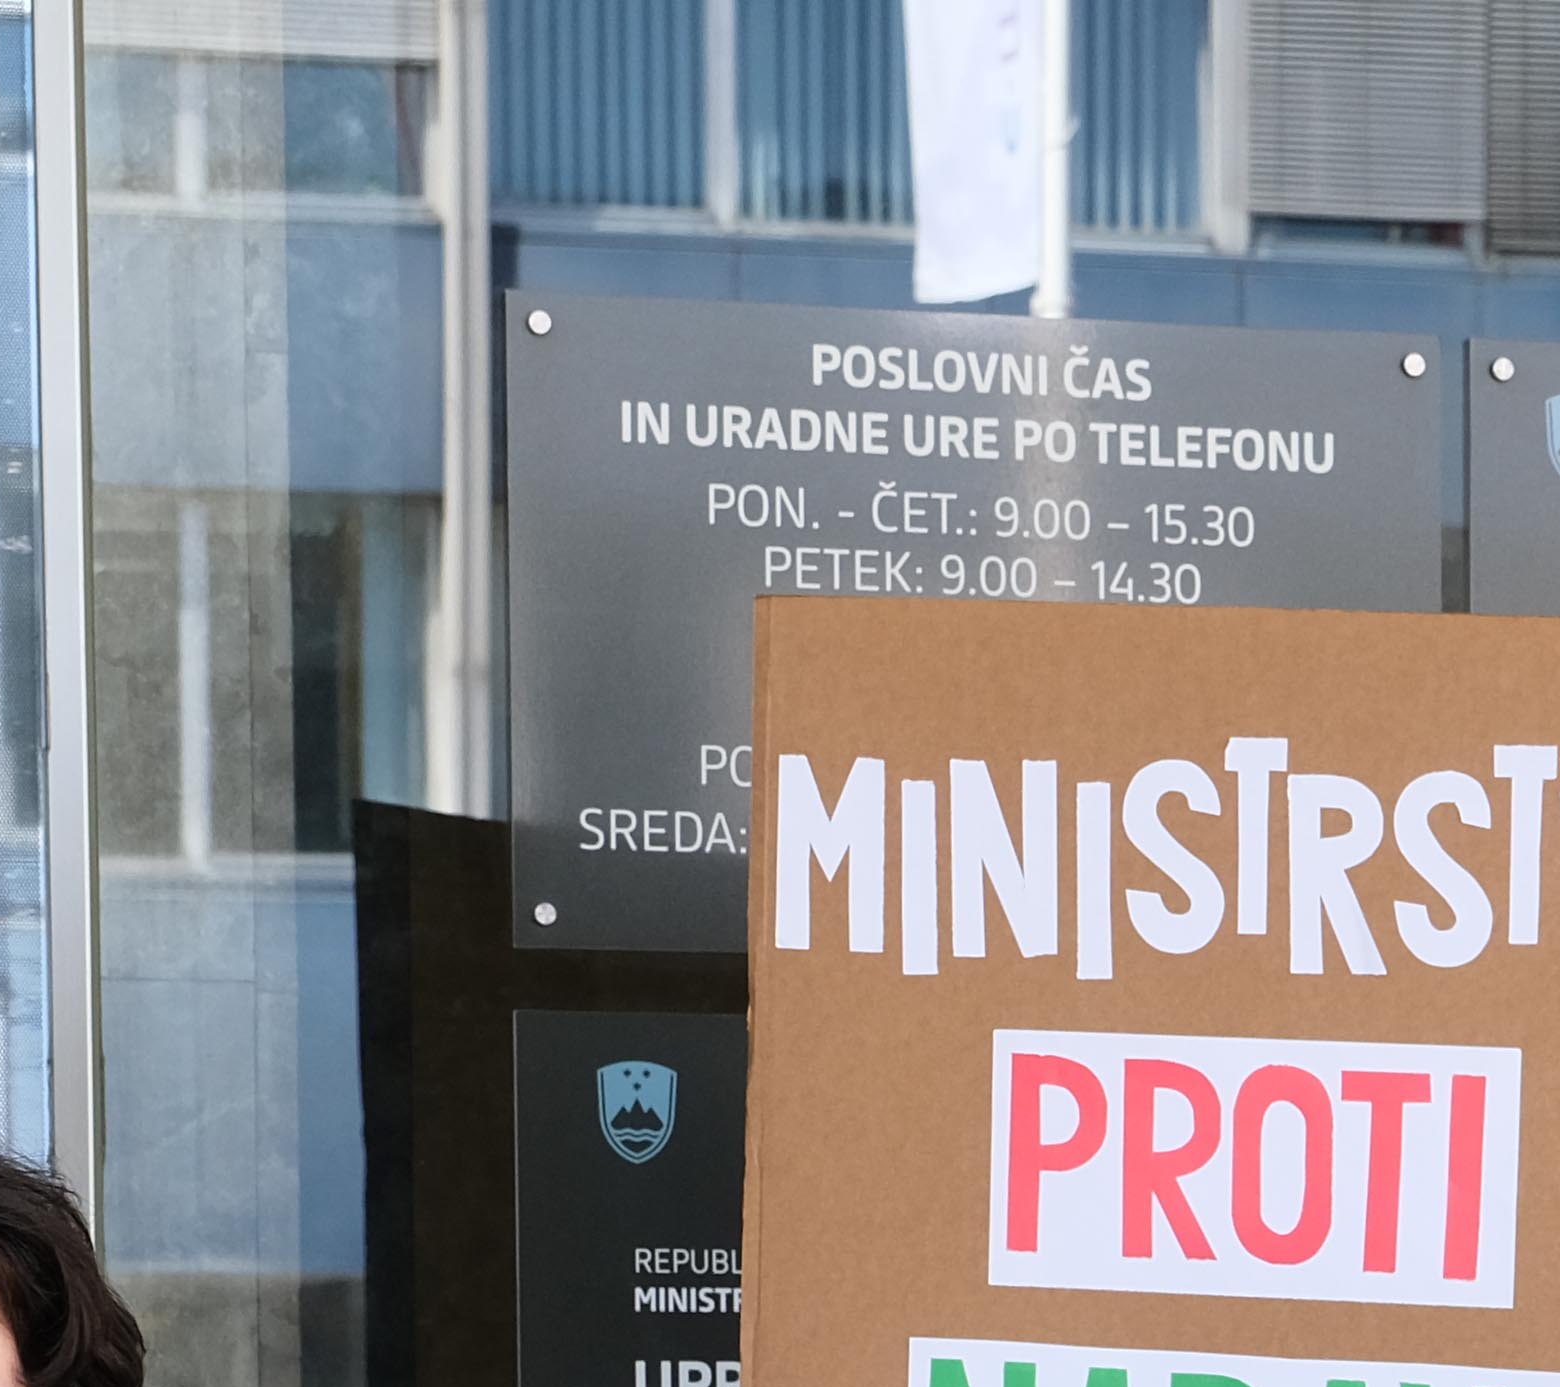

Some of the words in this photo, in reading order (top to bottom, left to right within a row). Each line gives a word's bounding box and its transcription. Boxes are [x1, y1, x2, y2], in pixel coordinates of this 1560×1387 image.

[811, 343, 1047, 396] POSLOVNI
[1062, 346, 1152, 401] ČAS
[620, 400, 670, 444] IN
[684, 403, 887, 455] URADNE
[903, 414, 999, 460] URE
[1014, 420, 1076, 463] PO
[1089, 422, 1334, 474] TELEFONU
[706, 482, 819, 530] PON.
[870, 480, 977, 537] ČET.:
[993, 497, 1091, 542] 9.00
[1144, 503, 1255, 548] 15.30
[763, 547, 923, 594] PETEK:
[939, 554, 1037, 598] 9.00
[1090, 559, 1202, 605] 14.30
[580, 808, 747, 854] SREDA:
[1006, 1053, 1486, 1281] PROTI
